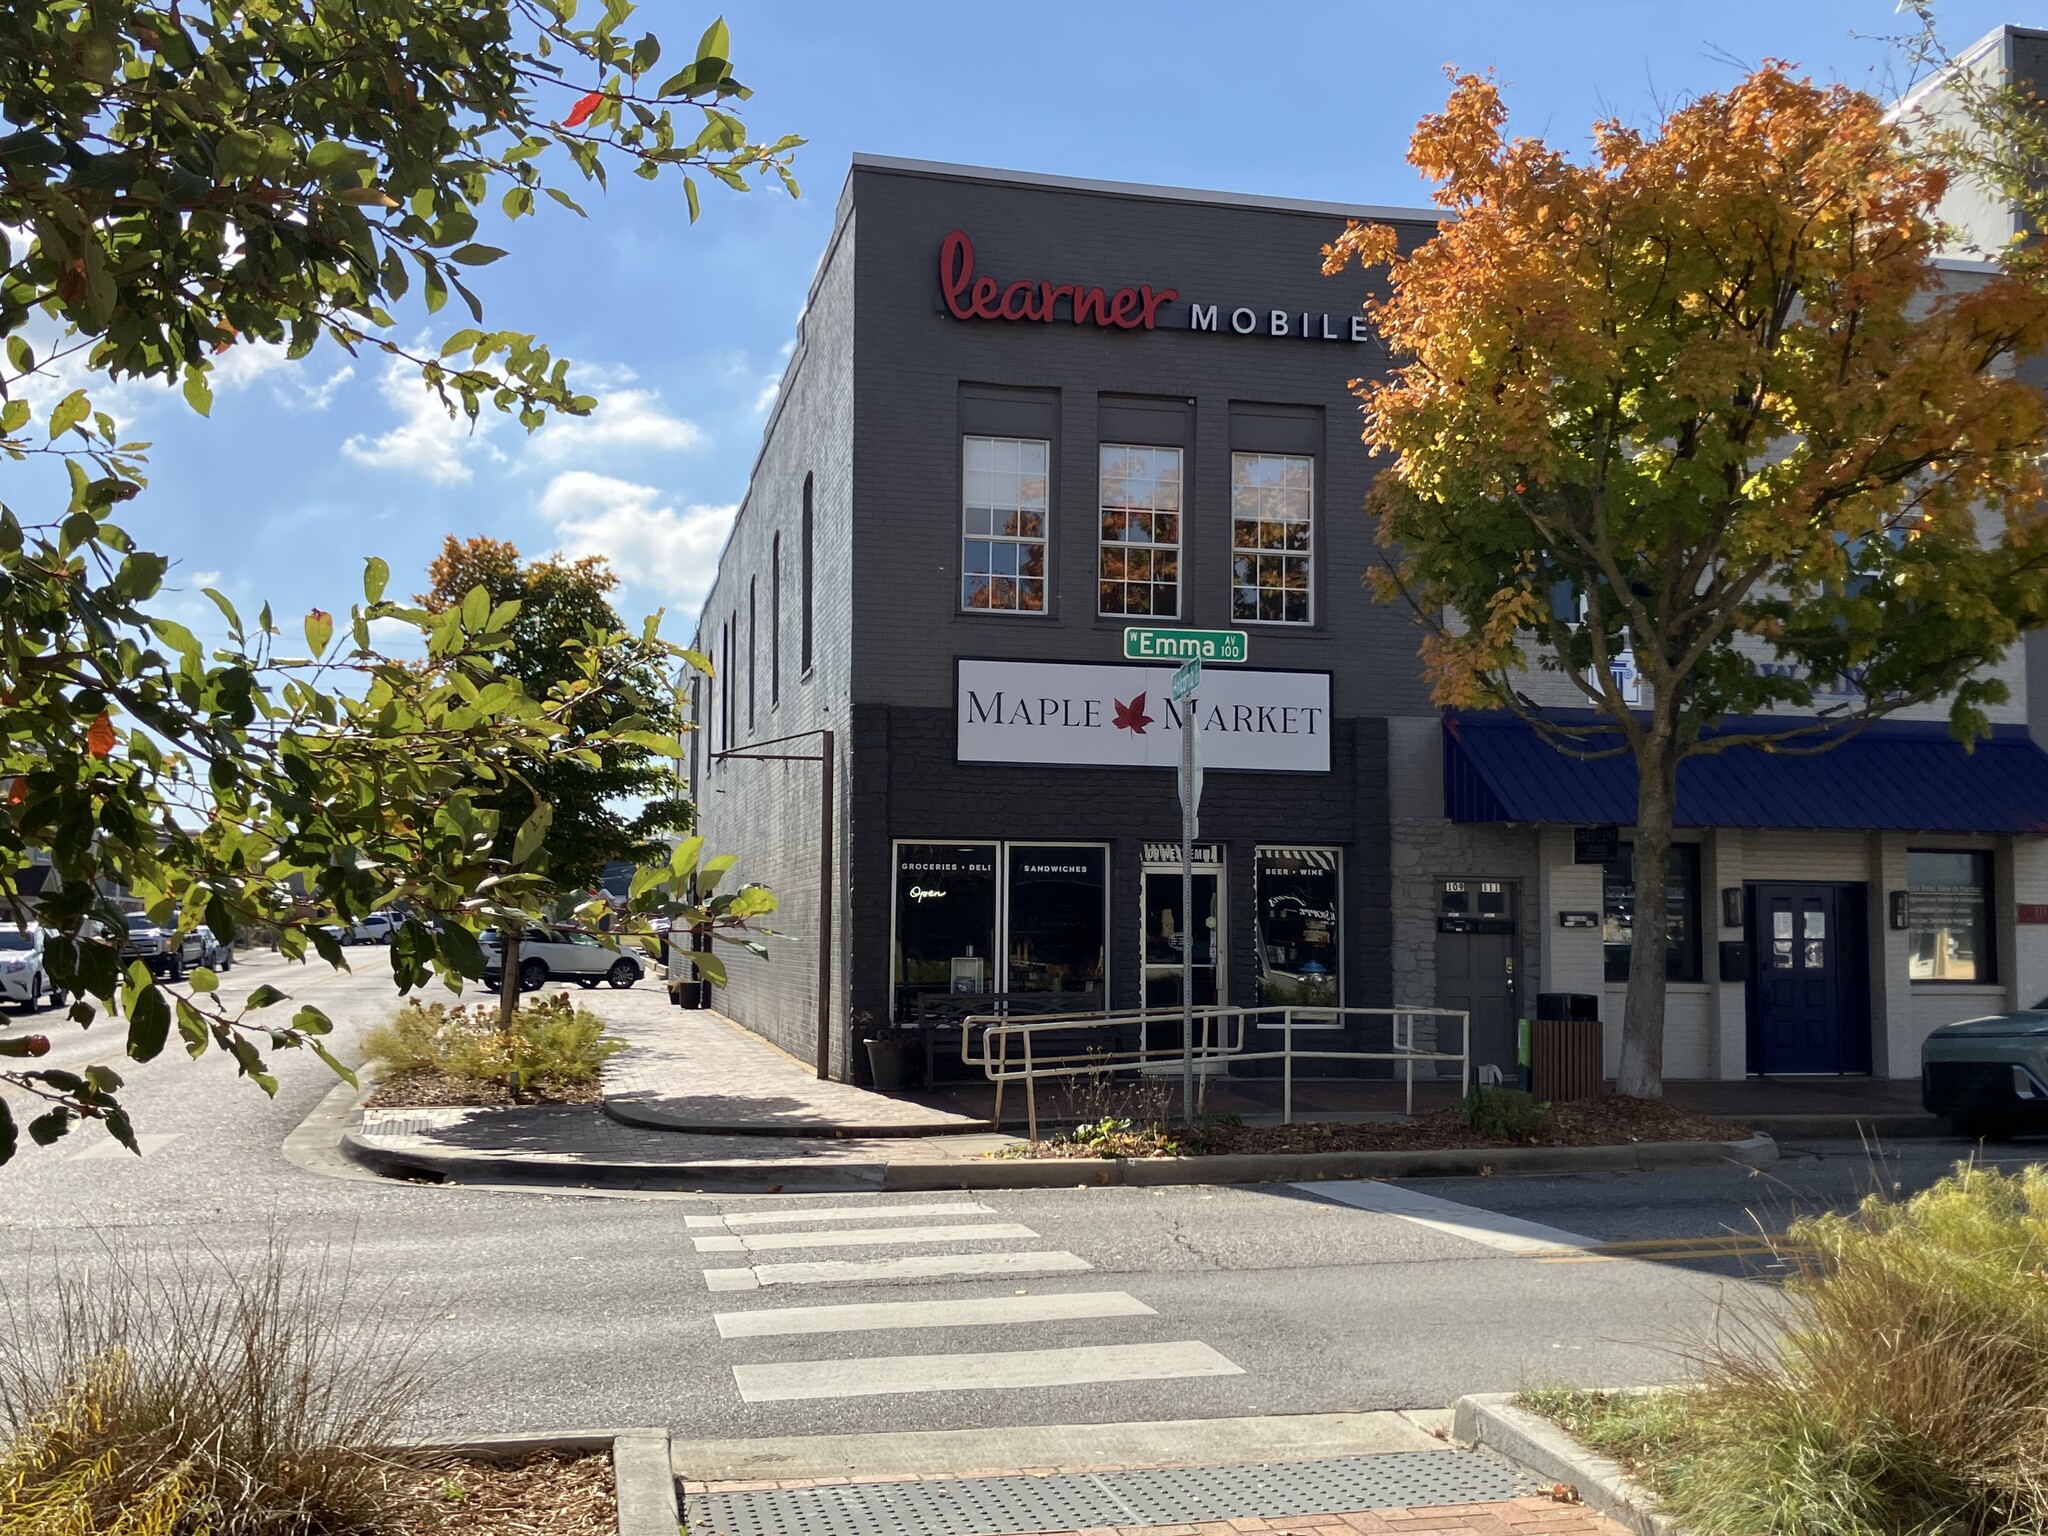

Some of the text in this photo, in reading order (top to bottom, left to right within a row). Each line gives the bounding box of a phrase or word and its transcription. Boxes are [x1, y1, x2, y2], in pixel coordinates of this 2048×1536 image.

[939, 229, 1368, 342] learner MOBILE
[1130, 632, 1215, 656] W Emma
[1224, 636, 1236, 646] AV
[1221, 646, 1239, 657] 100
[966, 690, 1322, 735] MAPLE MARKET
[901, 862, 991, 872] GROCERIES DELI
[1024, 864, 1087, 873] SANDWICHES
[1265, 868, 1324, 876] BEER WINE
[1447, 883, 1465, 891] 109
[1483, 883, 1499, 892] 111
[909, 885, 947, 904] Open
